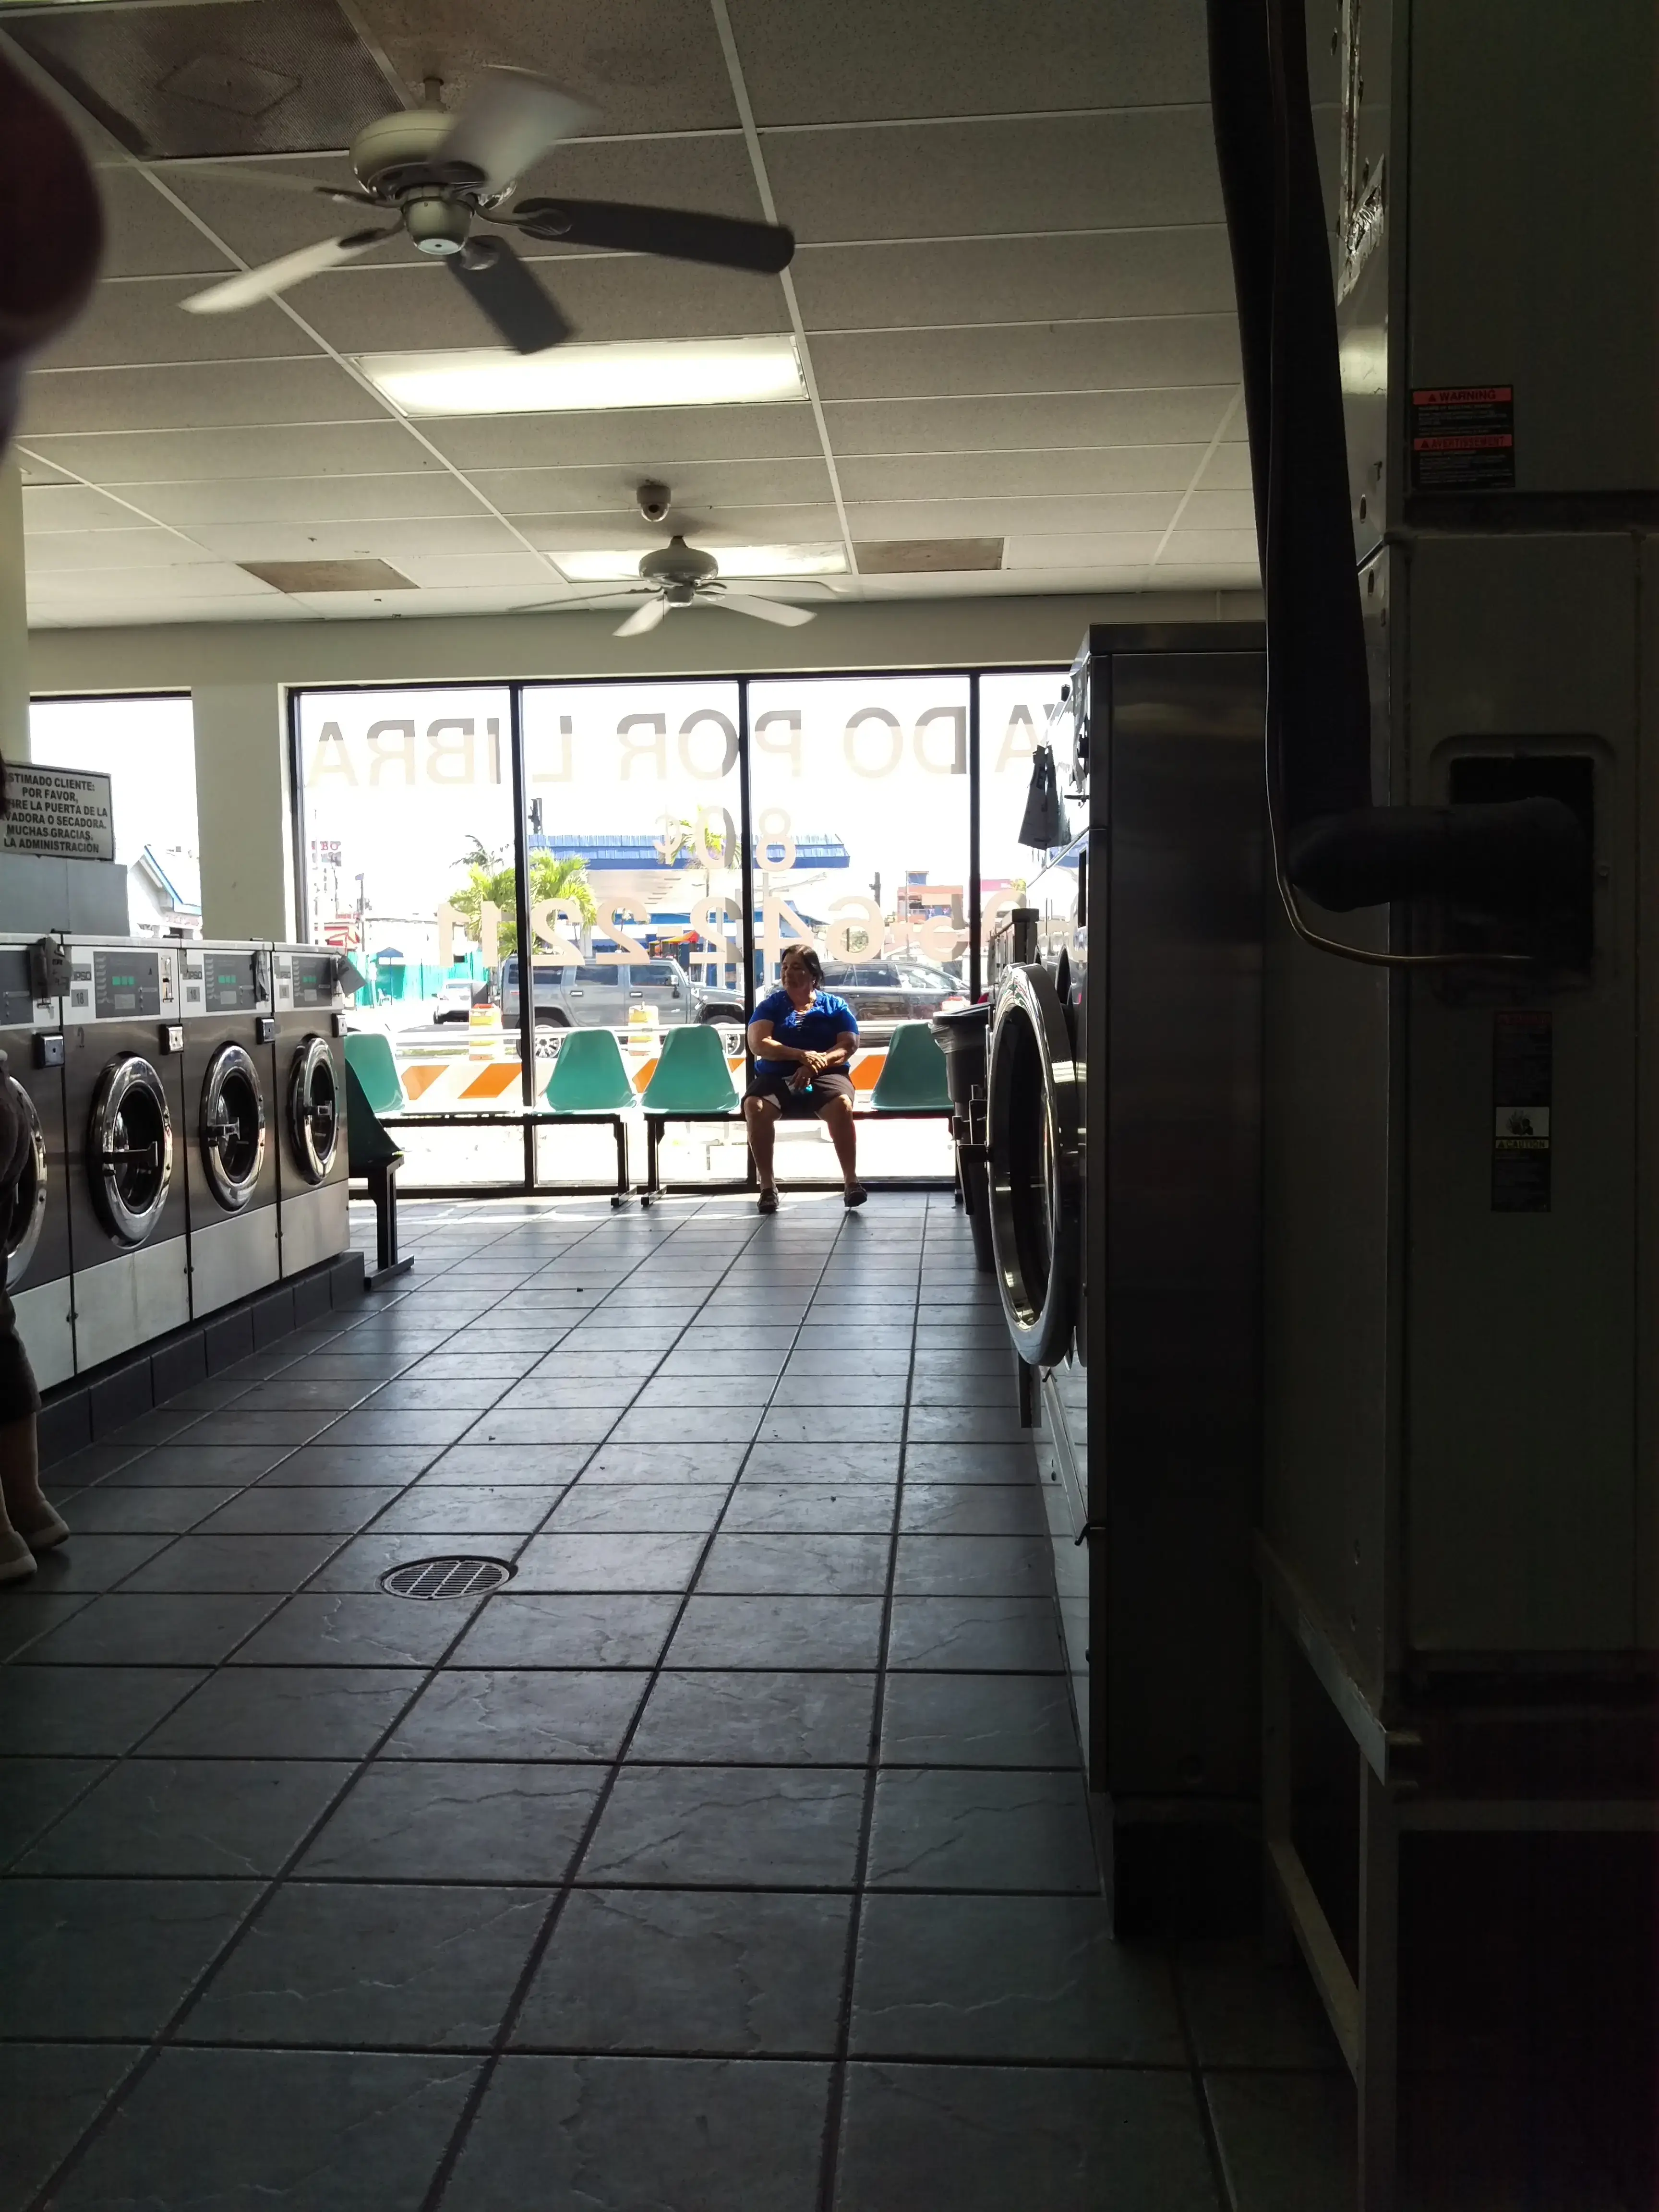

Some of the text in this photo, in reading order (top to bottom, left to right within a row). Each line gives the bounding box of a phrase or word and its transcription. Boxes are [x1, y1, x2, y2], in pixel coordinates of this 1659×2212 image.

[1440, 389, 1496, 401] WARNING
[8, 772, 95, 791] STIMADO CLIENTE:
[22, 787, 78, 804] POR FAVOR,
[30, 801, 42, 811] LA
[45, 802, 82, 815] PUERTA
[84, 806, 95, 816] DE
[97, 807, 108, 817] LA
[5, 811, 107, 829] VADORA O SECADORA.
[7, 824, 48, 836] MUCHAS
[4, 838, 16, 848] LA
[76, 992, 84, 1004] 18
